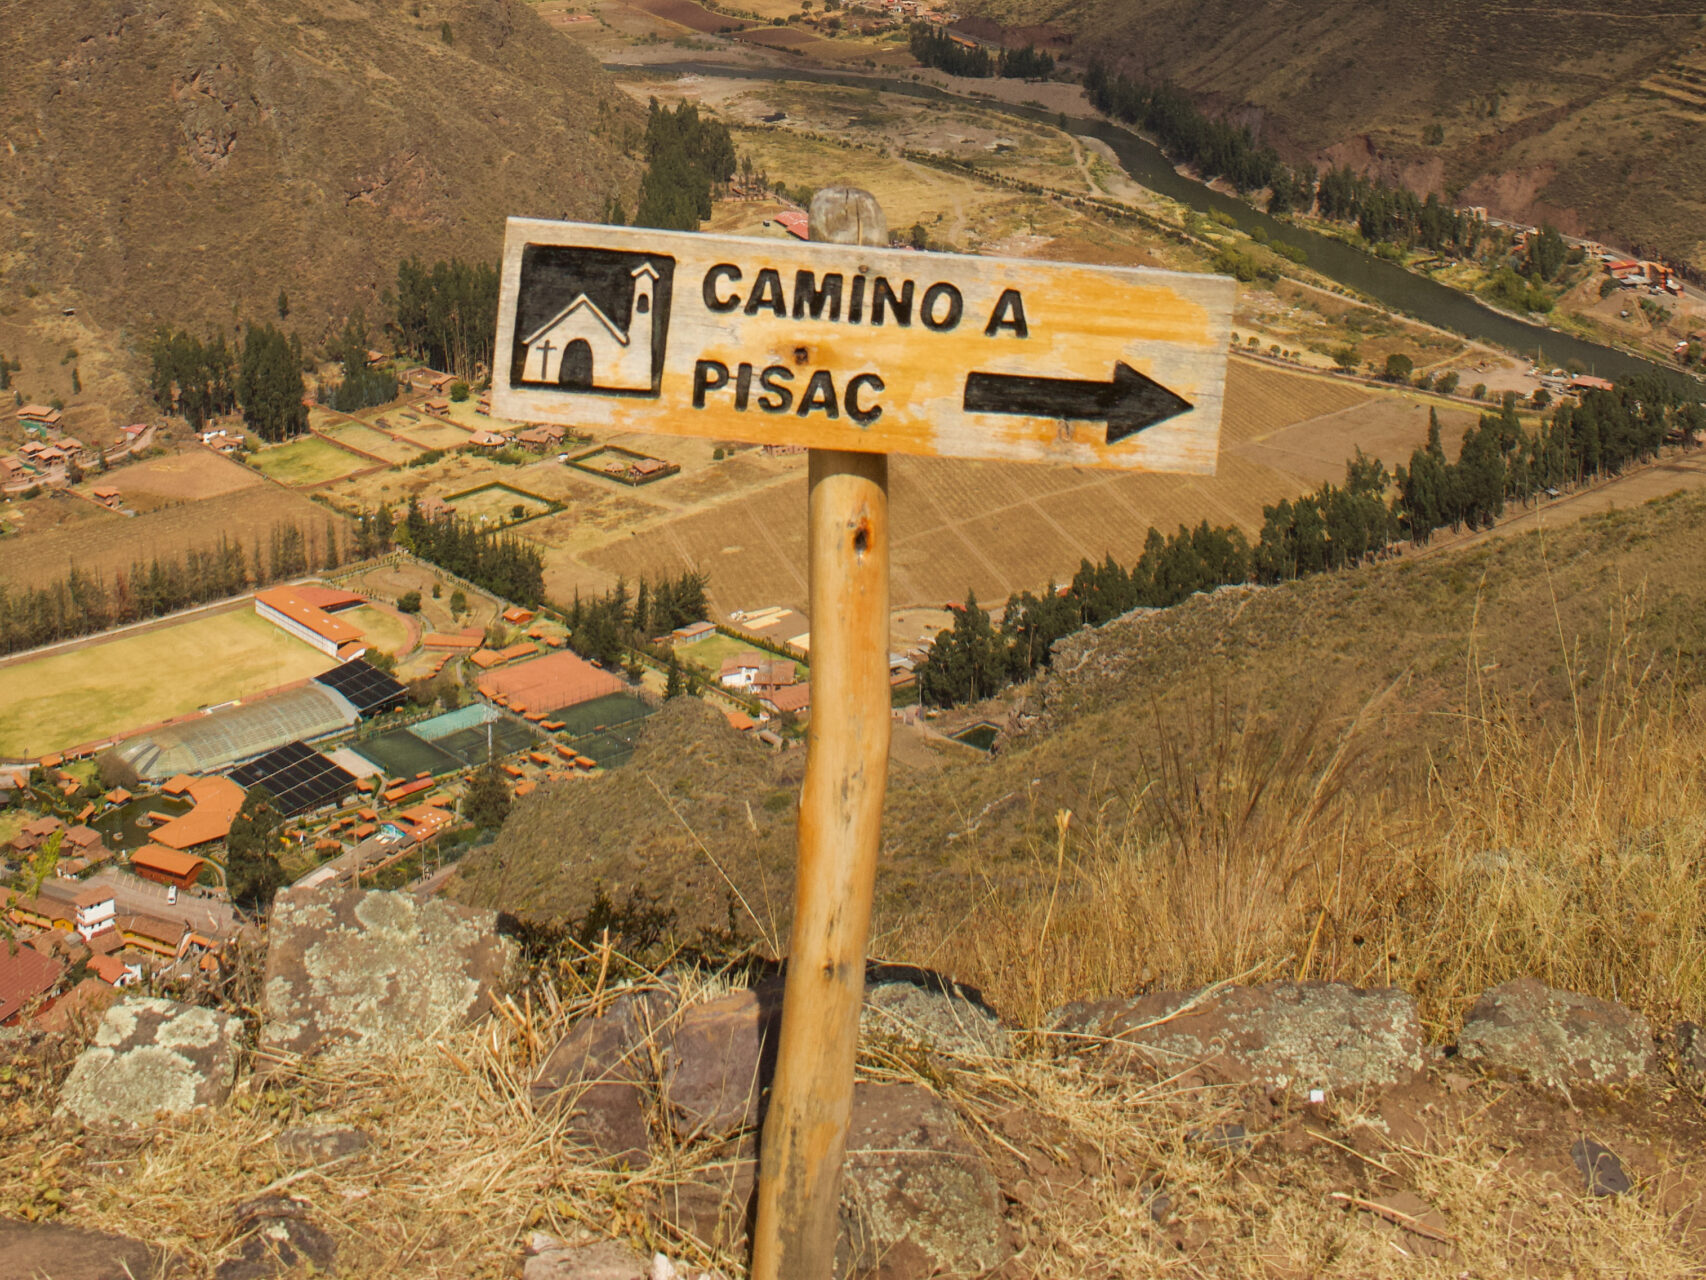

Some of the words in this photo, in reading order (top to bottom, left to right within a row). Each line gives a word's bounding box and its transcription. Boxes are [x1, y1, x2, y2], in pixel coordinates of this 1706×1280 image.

[702, 263, 964, 332] CAMINO
[984, 288, 1029, 339] A
[692, 359, 885, 426] PISAC
